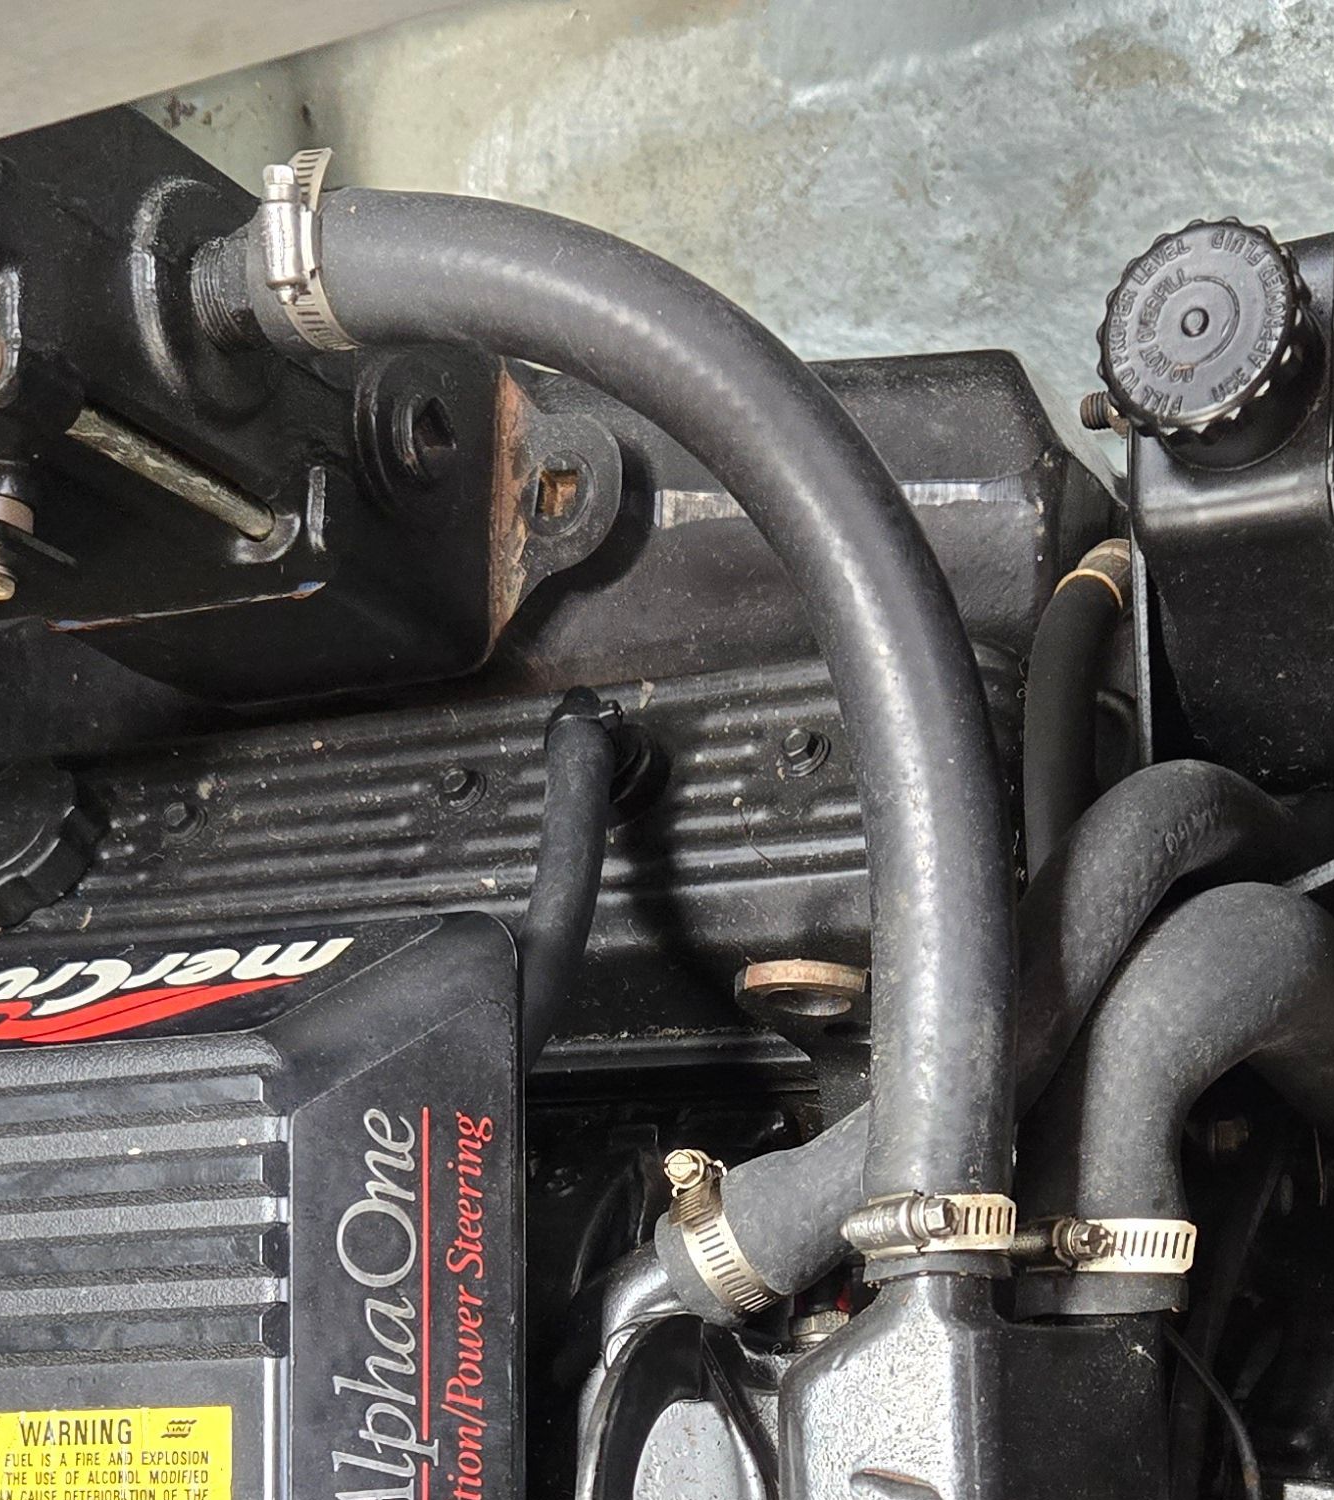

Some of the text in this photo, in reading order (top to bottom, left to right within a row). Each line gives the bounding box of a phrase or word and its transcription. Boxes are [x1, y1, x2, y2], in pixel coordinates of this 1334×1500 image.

[1211, 229, 1268, 266] FLUID
[1110, 290, 1136, 366] PROPER
[1133, 239, 1191, 285] LEVEL
[1137, 270, 1193, 343] OVERFILL
[1141, 346, 1172, 377] NOT
[442, 1111, 492, 1279] Steering
[20, 1419, 132, 1446] WARNING
[5, 1454, 33, 1467] FUEL
[41, 1453, 51, 1467] IS
[59, 1453, 67, 1467] A
[75, 1452, 100, 1466] FIRE
[108, 1452, 133, 1465] AND
[142, 1451, 209, 1465] EXPLOSION
[5, 1472, 27, 1485] THE
[35, 1472, 56, 1485] USE
[65, 1472, 79, 1485] OF
[87, 1471, 140, 1484] ALCOHOL
[149, 1470, 208, 1484] MODIFIED
